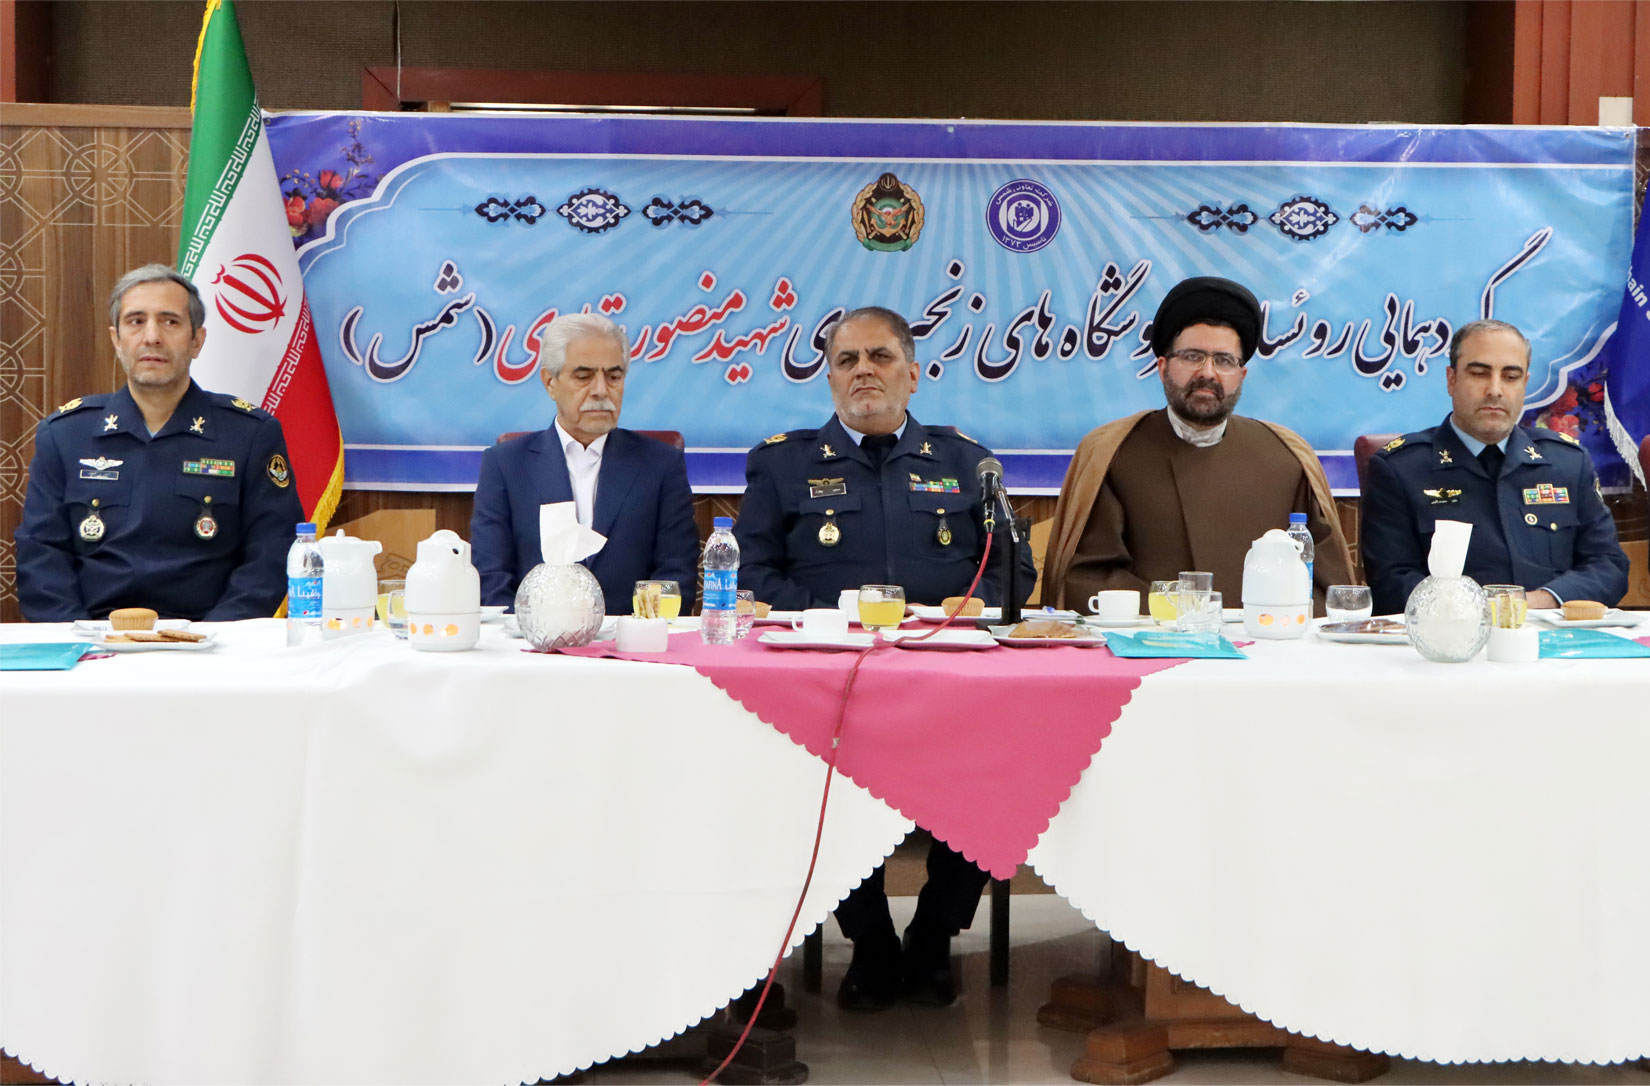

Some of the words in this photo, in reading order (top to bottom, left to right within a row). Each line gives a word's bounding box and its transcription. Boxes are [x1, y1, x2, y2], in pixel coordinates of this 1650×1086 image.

[629, 270, 748, 364] منصور
[691, 276, 799, 386] شهید
[973, 288, 1056, 382] های
[1350, 226, 1553, 392] گدهمایی
